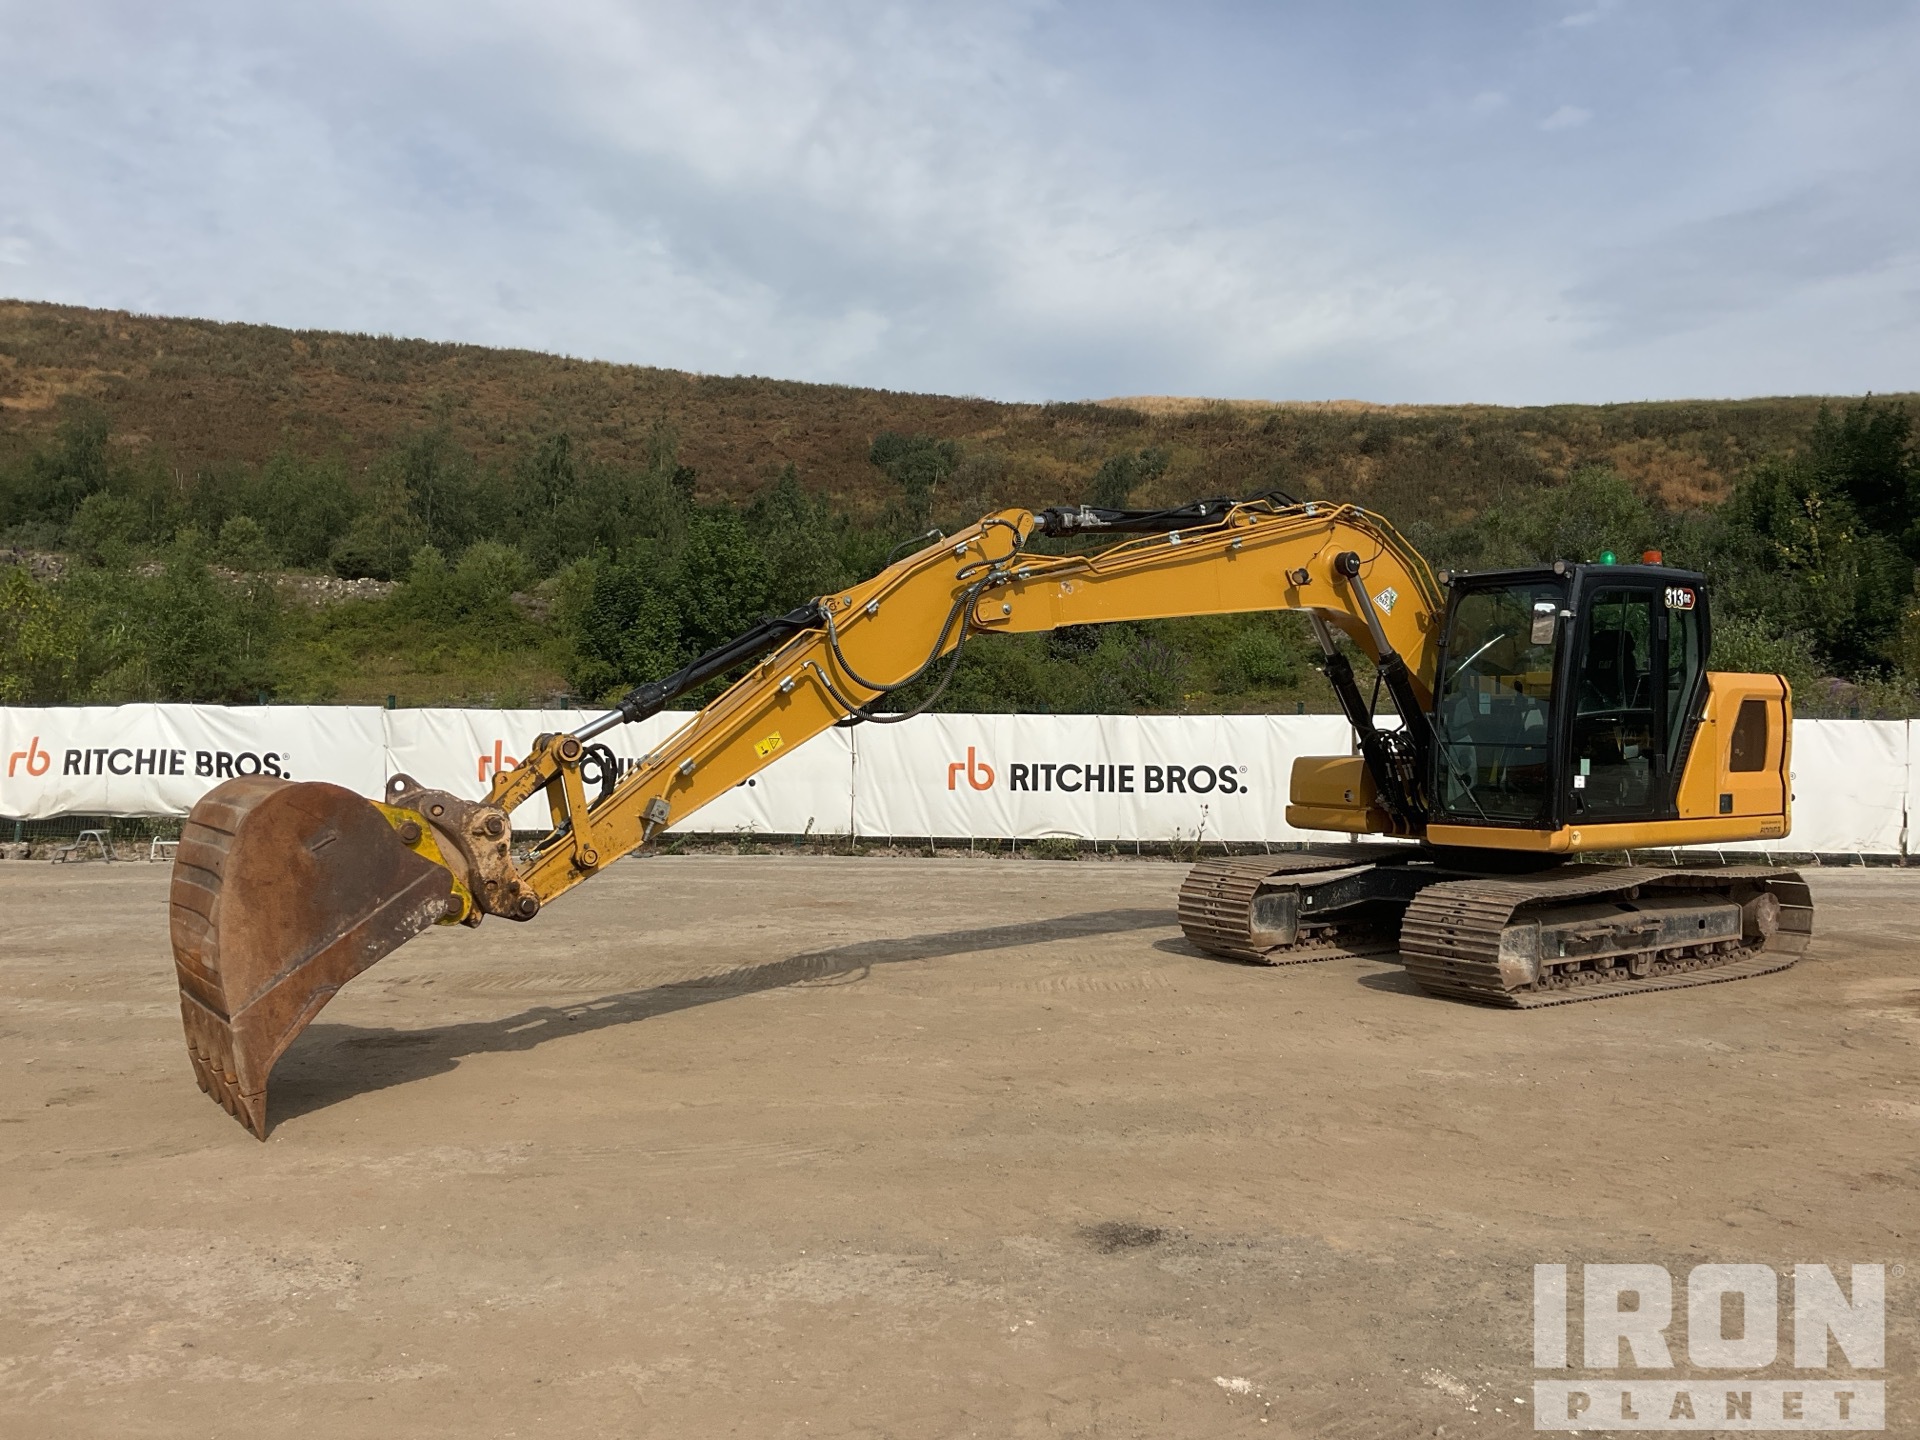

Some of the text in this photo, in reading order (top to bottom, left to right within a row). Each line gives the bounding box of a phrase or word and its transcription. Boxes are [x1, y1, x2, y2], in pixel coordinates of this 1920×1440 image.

[8, 736, 51, 777] rb
[63, 748, 185, 776] RITCHIE
[948, 746, 995, 791] rb
[1010, 764, 1134, 793] RITCHIE
